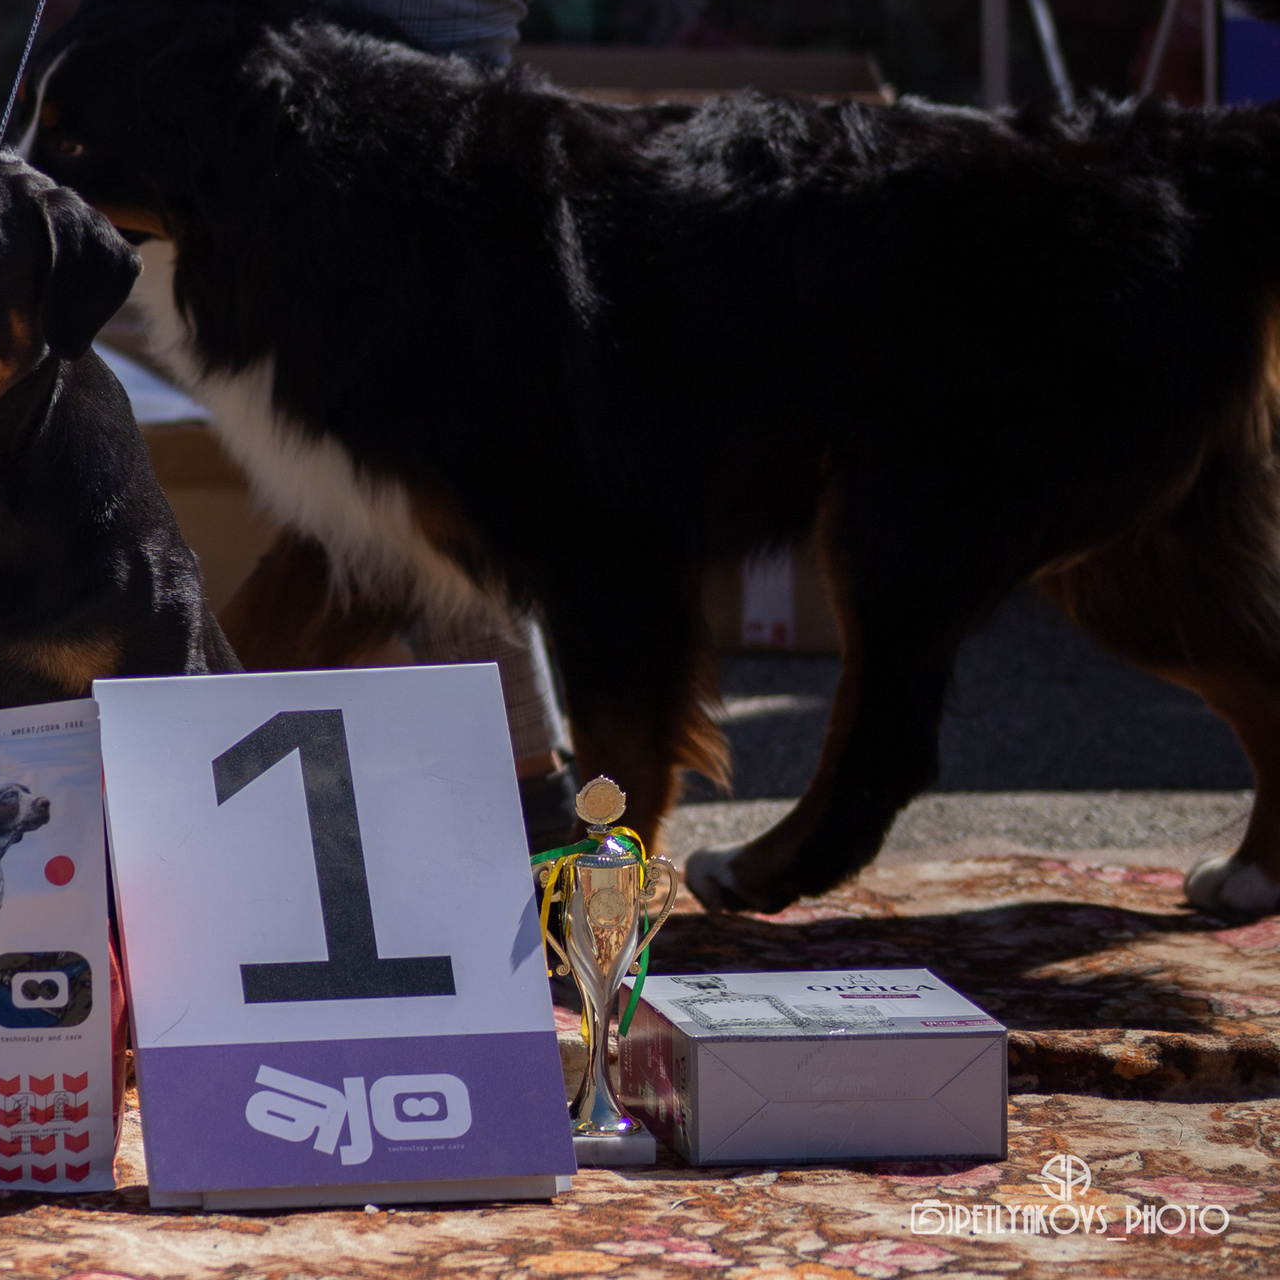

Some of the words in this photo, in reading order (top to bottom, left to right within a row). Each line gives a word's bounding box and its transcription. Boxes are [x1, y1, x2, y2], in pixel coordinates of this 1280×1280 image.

[11, 723, 60, 736] WHEAT/CORN
[65, 720, 84, 730] FREE
[211, 708, 456, 1004] 1
[806, 984, 941, 992] OPTICA
[1, 1035, 43, 1043] technology
[388, 1145, 428, 1153] technology
